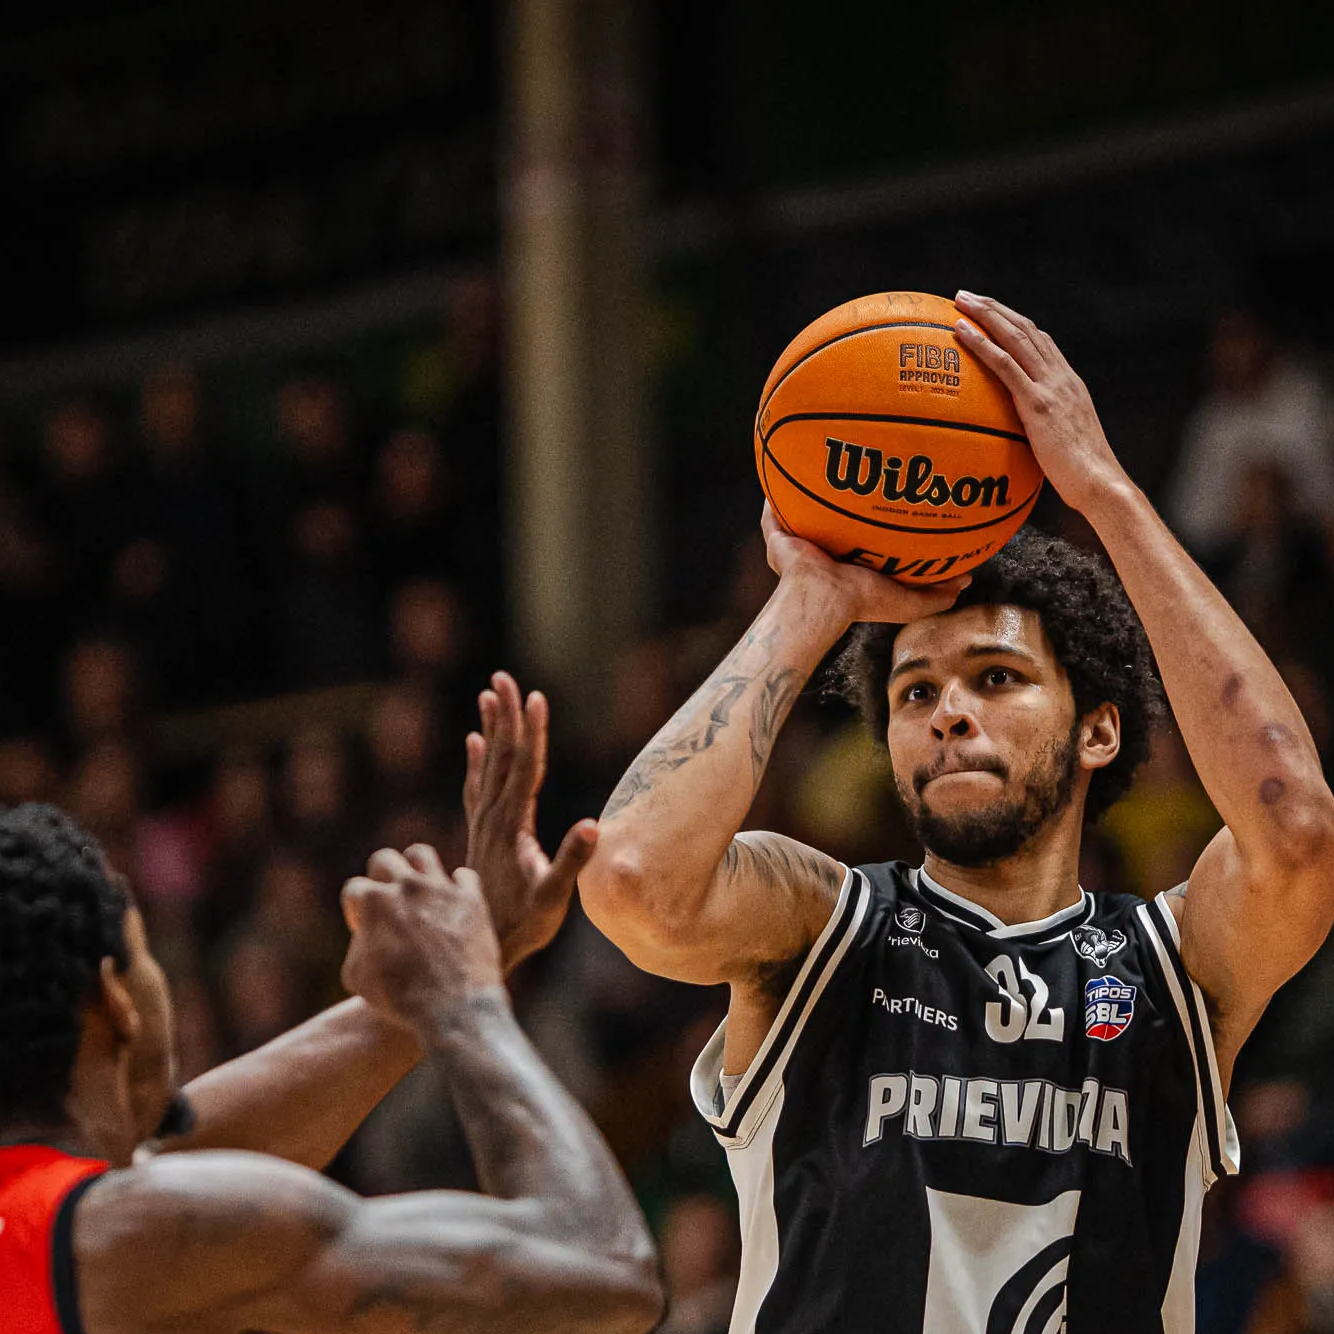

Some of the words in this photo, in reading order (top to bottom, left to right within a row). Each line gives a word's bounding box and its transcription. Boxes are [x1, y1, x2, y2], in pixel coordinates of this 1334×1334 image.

[899, 343, 960, 373] FIBA
[899, 370, 960, 387] APPROVED
[825, 437, 1009, 508] Wilson
[872, 504, 909, 515] INDOOR
[912, 510, 938, 518] GAME
[984, 954, 1065, 1043] 32
[1087, 987, 1132, 1002] TIPOS
[872, 988, 958, 1031] PARTNERS
[1085, 1002, 1127, 1029] SBL
